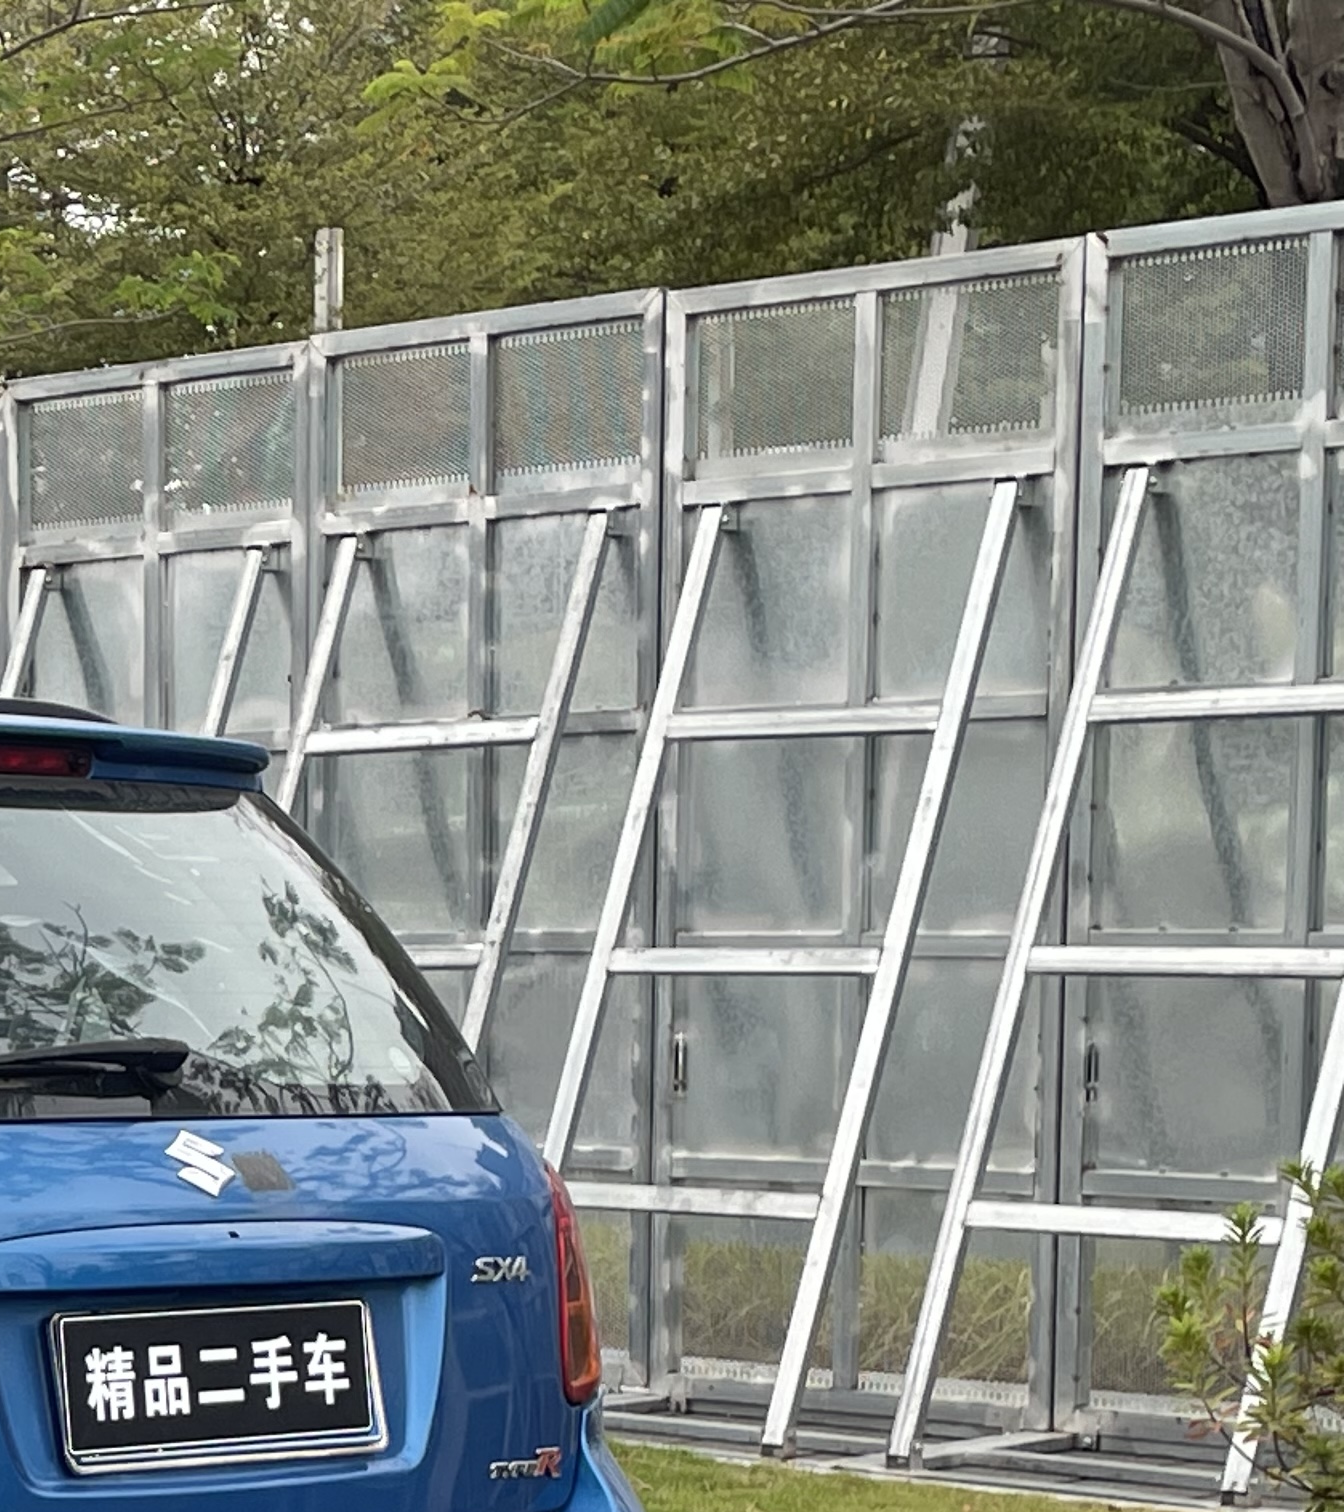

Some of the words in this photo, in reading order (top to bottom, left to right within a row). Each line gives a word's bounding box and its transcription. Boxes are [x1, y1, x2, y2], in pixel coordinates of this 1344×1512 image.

[470, 1256, 531, 1283] SX4
[85, 1333, 351, 1421] 精品二手车
